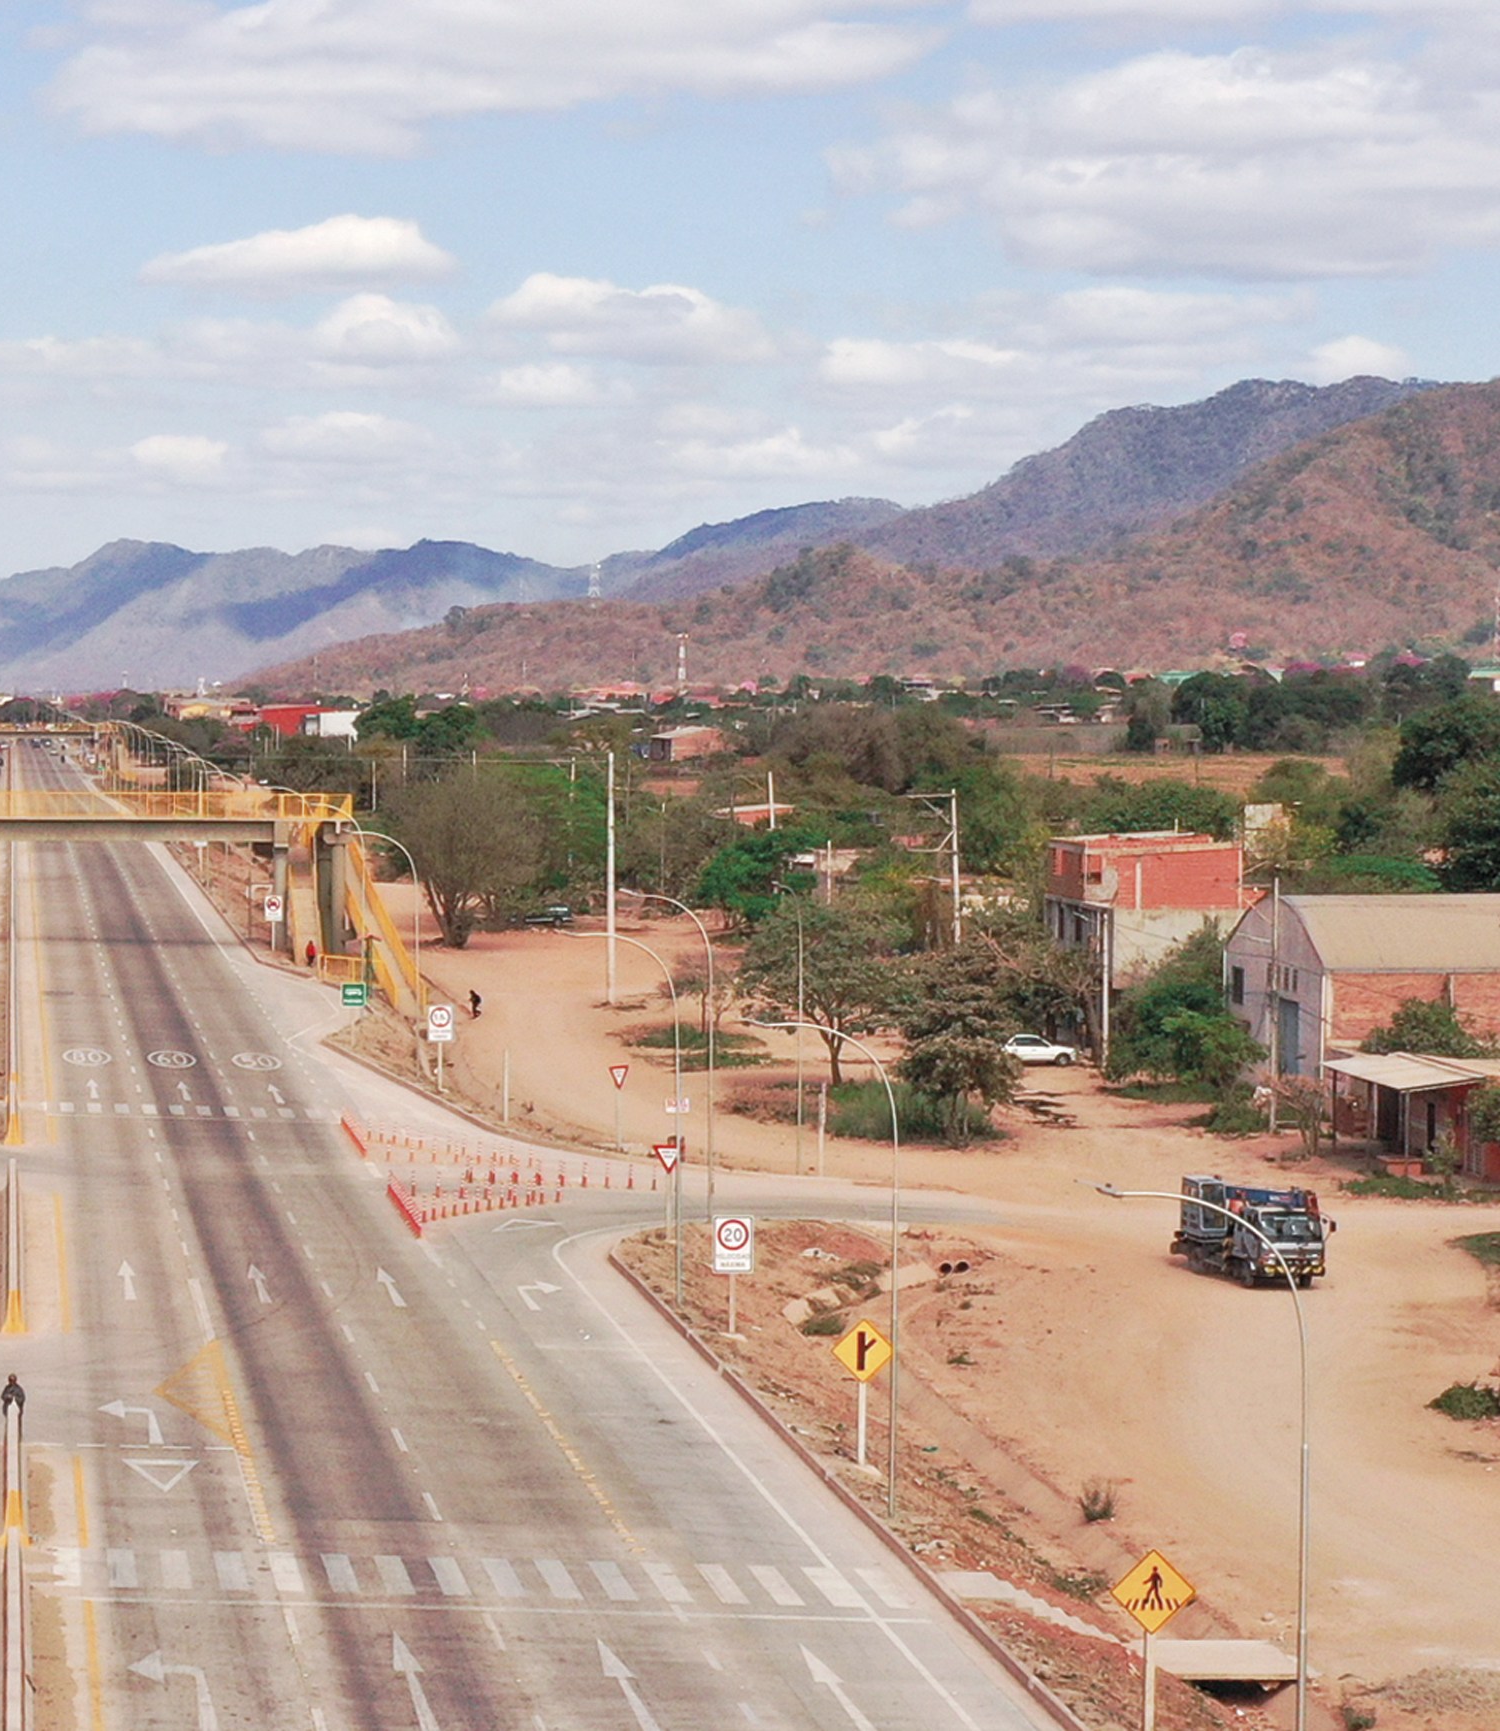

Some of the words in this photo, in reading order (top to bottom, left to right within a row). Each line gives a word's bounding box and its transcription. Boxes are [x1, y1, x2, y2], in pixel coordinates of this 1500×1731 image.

[73, 1051, 102, 1063] 80
[157, 1053, 187, 1065] 60
[240, 1055, 273, 1067] 50
[724, 1228, 743, 1242] 20
